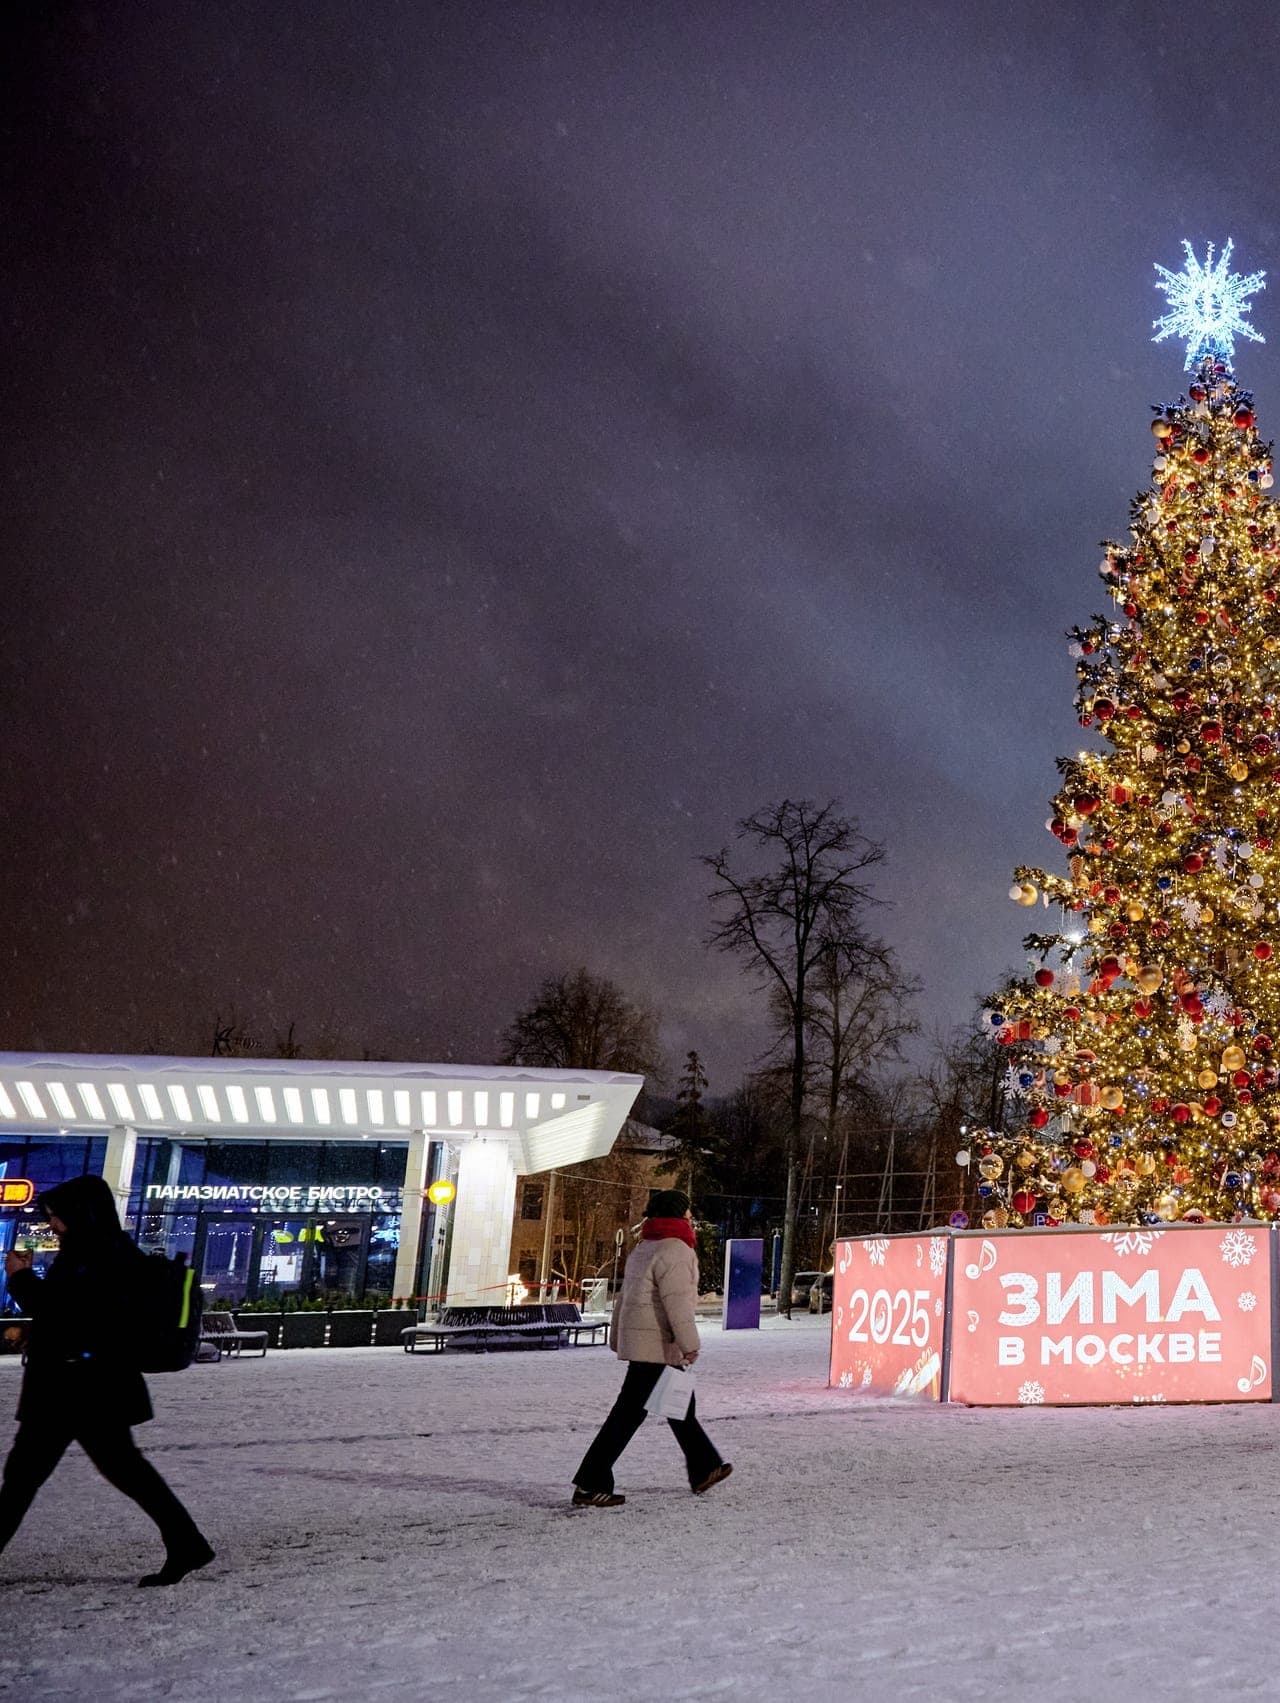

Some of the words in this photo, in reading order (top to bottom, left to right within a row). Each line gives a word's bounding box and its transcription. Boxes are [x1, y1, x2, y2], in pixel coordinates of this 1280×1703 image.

[146, 1185, 302, 1199] ПАНАЗИАТСКОЕ
[308, 1186, 383, 1199] БИСТРО
[848, 1289, 931, 1347] 2025
[998, 1267, 1221, 1327] ЗИМА
[998, 1336, 1025, 1366] В
[1041, 1331, 1222, 1365] МОСКВЕ
